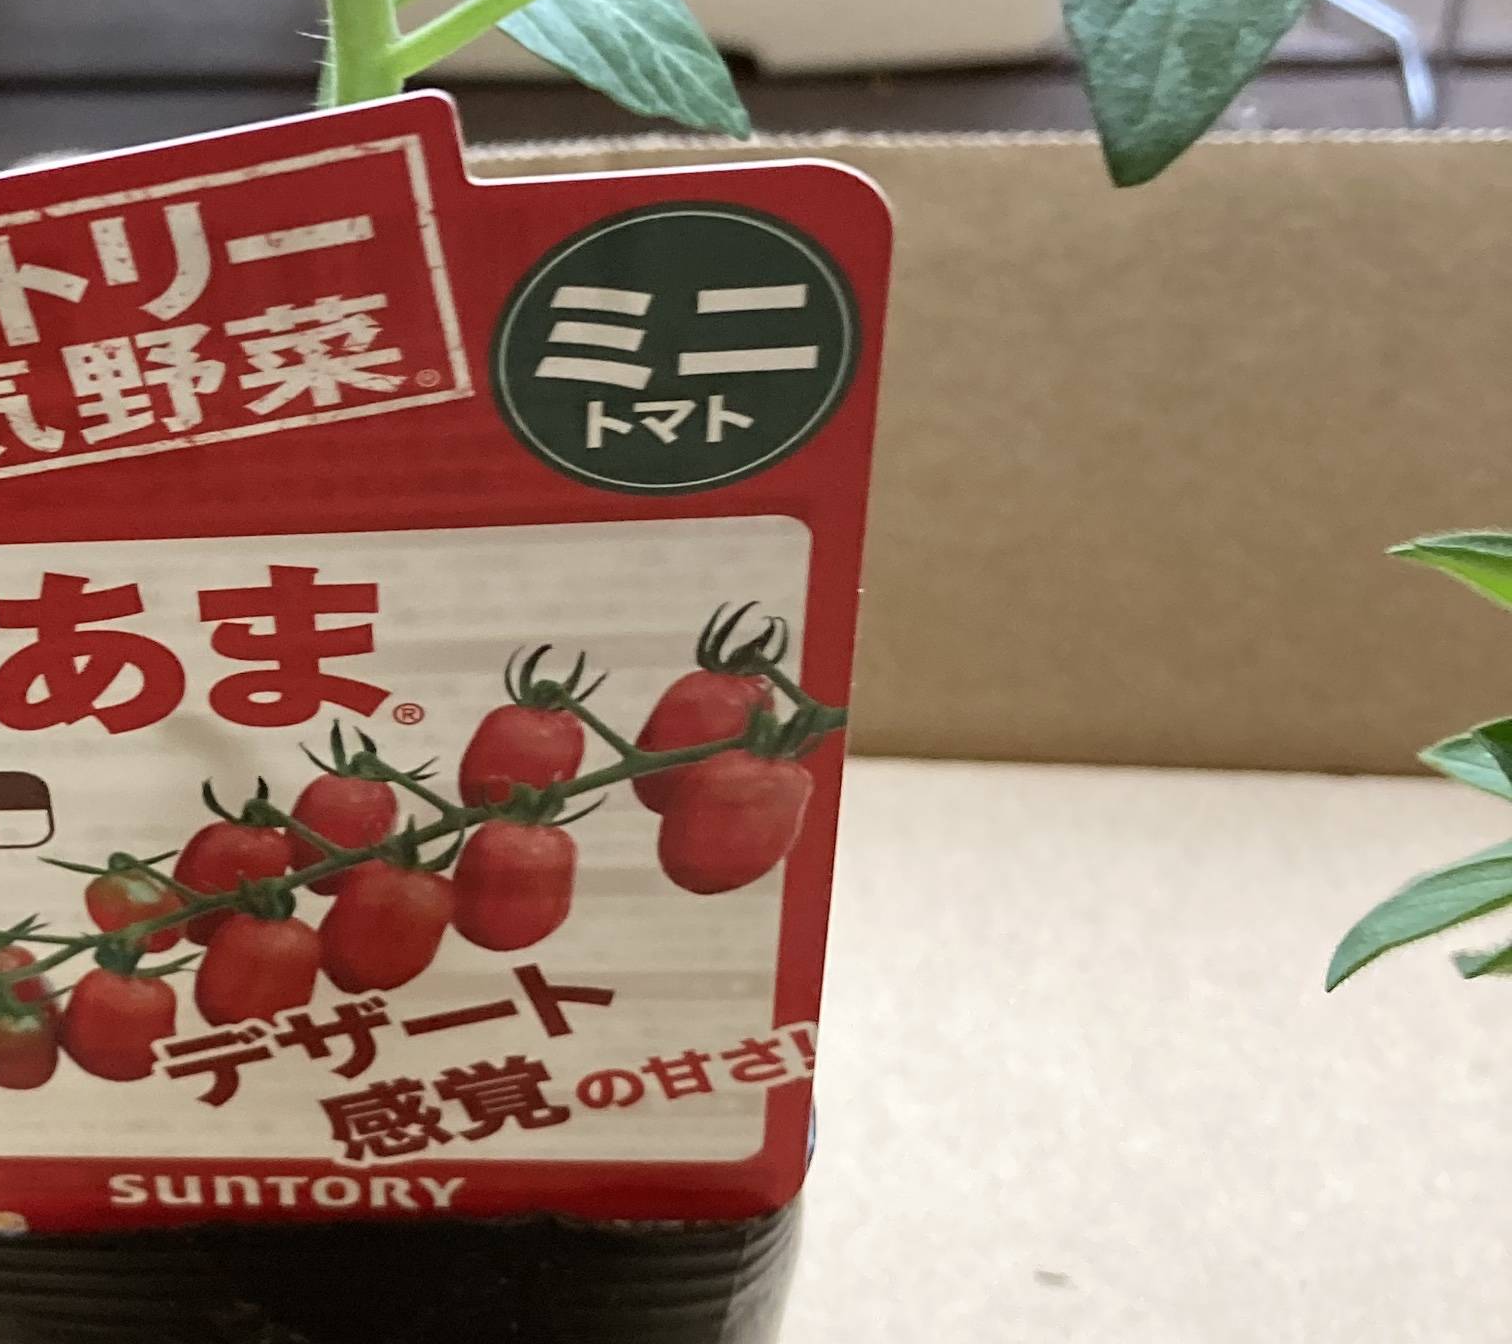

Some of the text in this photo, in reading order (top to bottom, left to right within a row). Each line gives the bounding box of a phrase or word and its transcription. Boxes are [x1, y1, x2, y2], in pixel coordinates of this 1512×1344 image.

[535, 284, 820, 390] ミニ
[587, 395, 755, 450] トマト
[163, 965, 616, 1107] デザート
